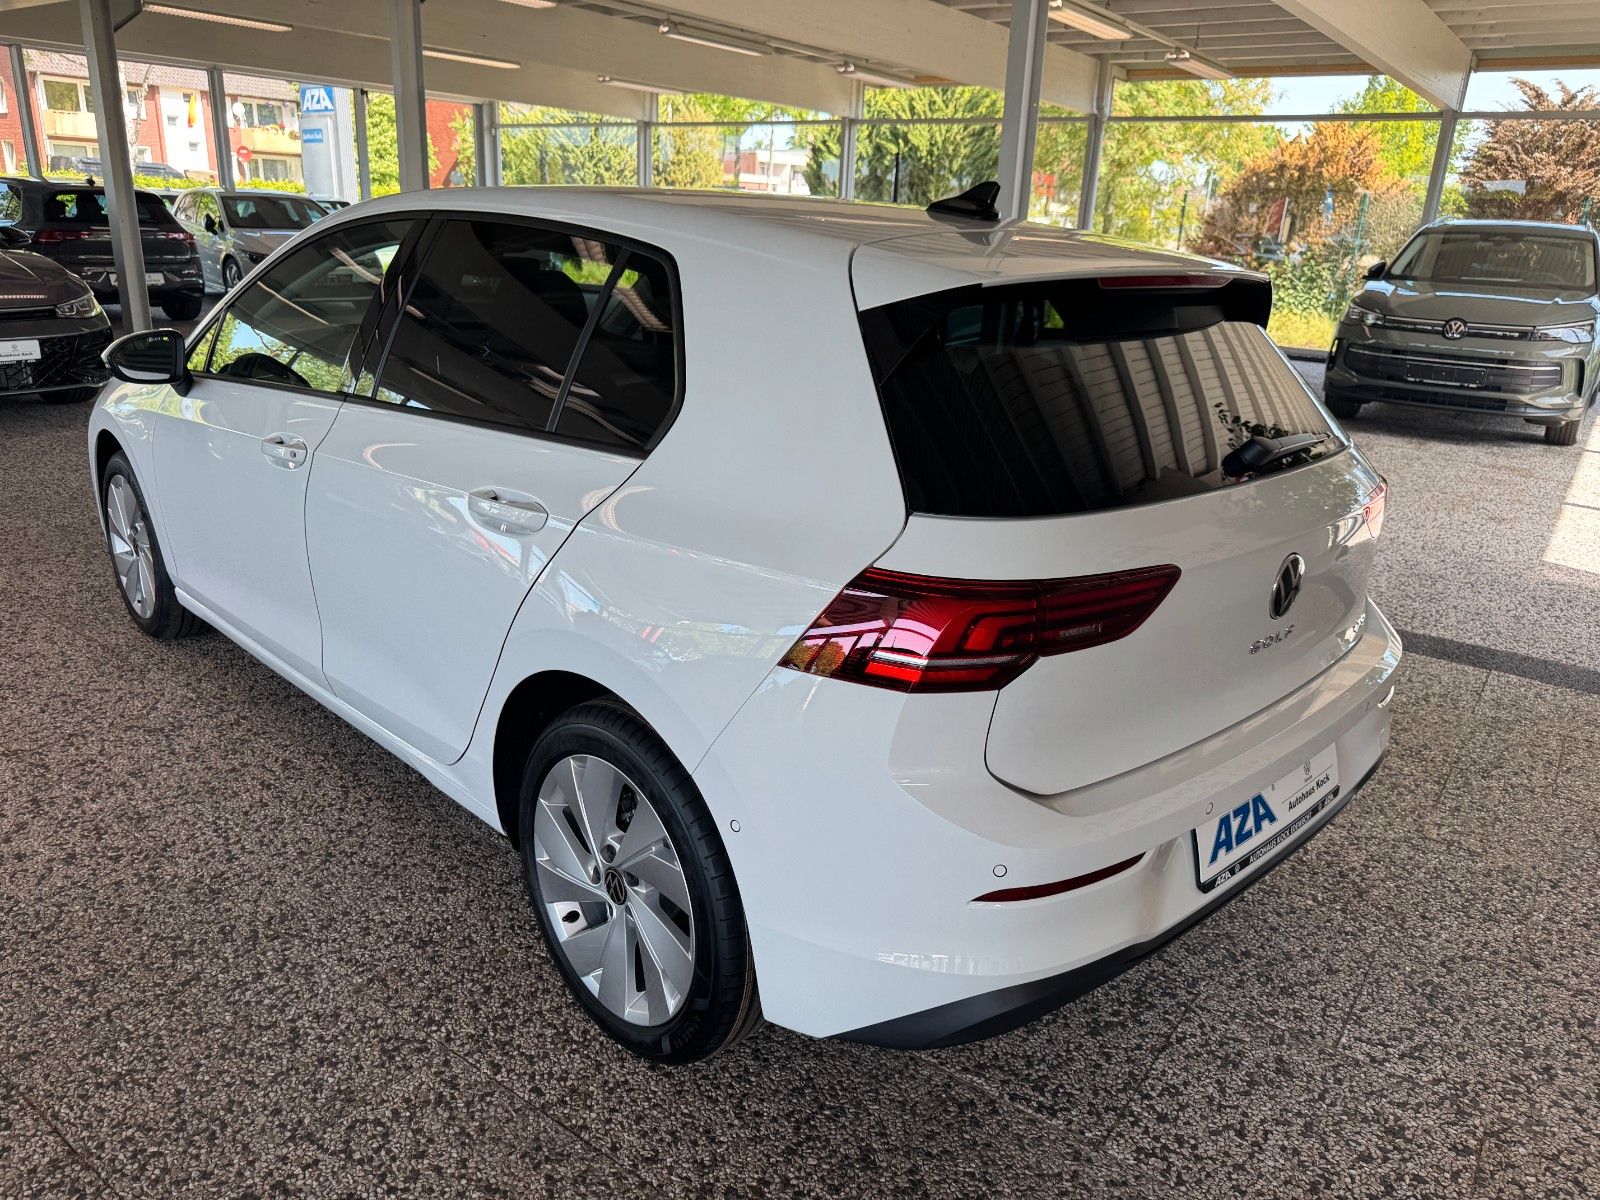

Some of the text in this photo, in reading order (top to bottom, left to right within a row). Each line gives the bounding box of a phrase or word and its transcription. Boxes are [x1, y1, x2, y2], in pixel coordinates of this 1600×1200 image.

[304, 88, 334, 111] AZA
[1249, 624, 1295, 654] GOLF
[1288, 773, 1330, 812] Autohaus Kock
[1208, 792, 1279, 867] AZA
[1215, 871, 1232, 887] AZA
